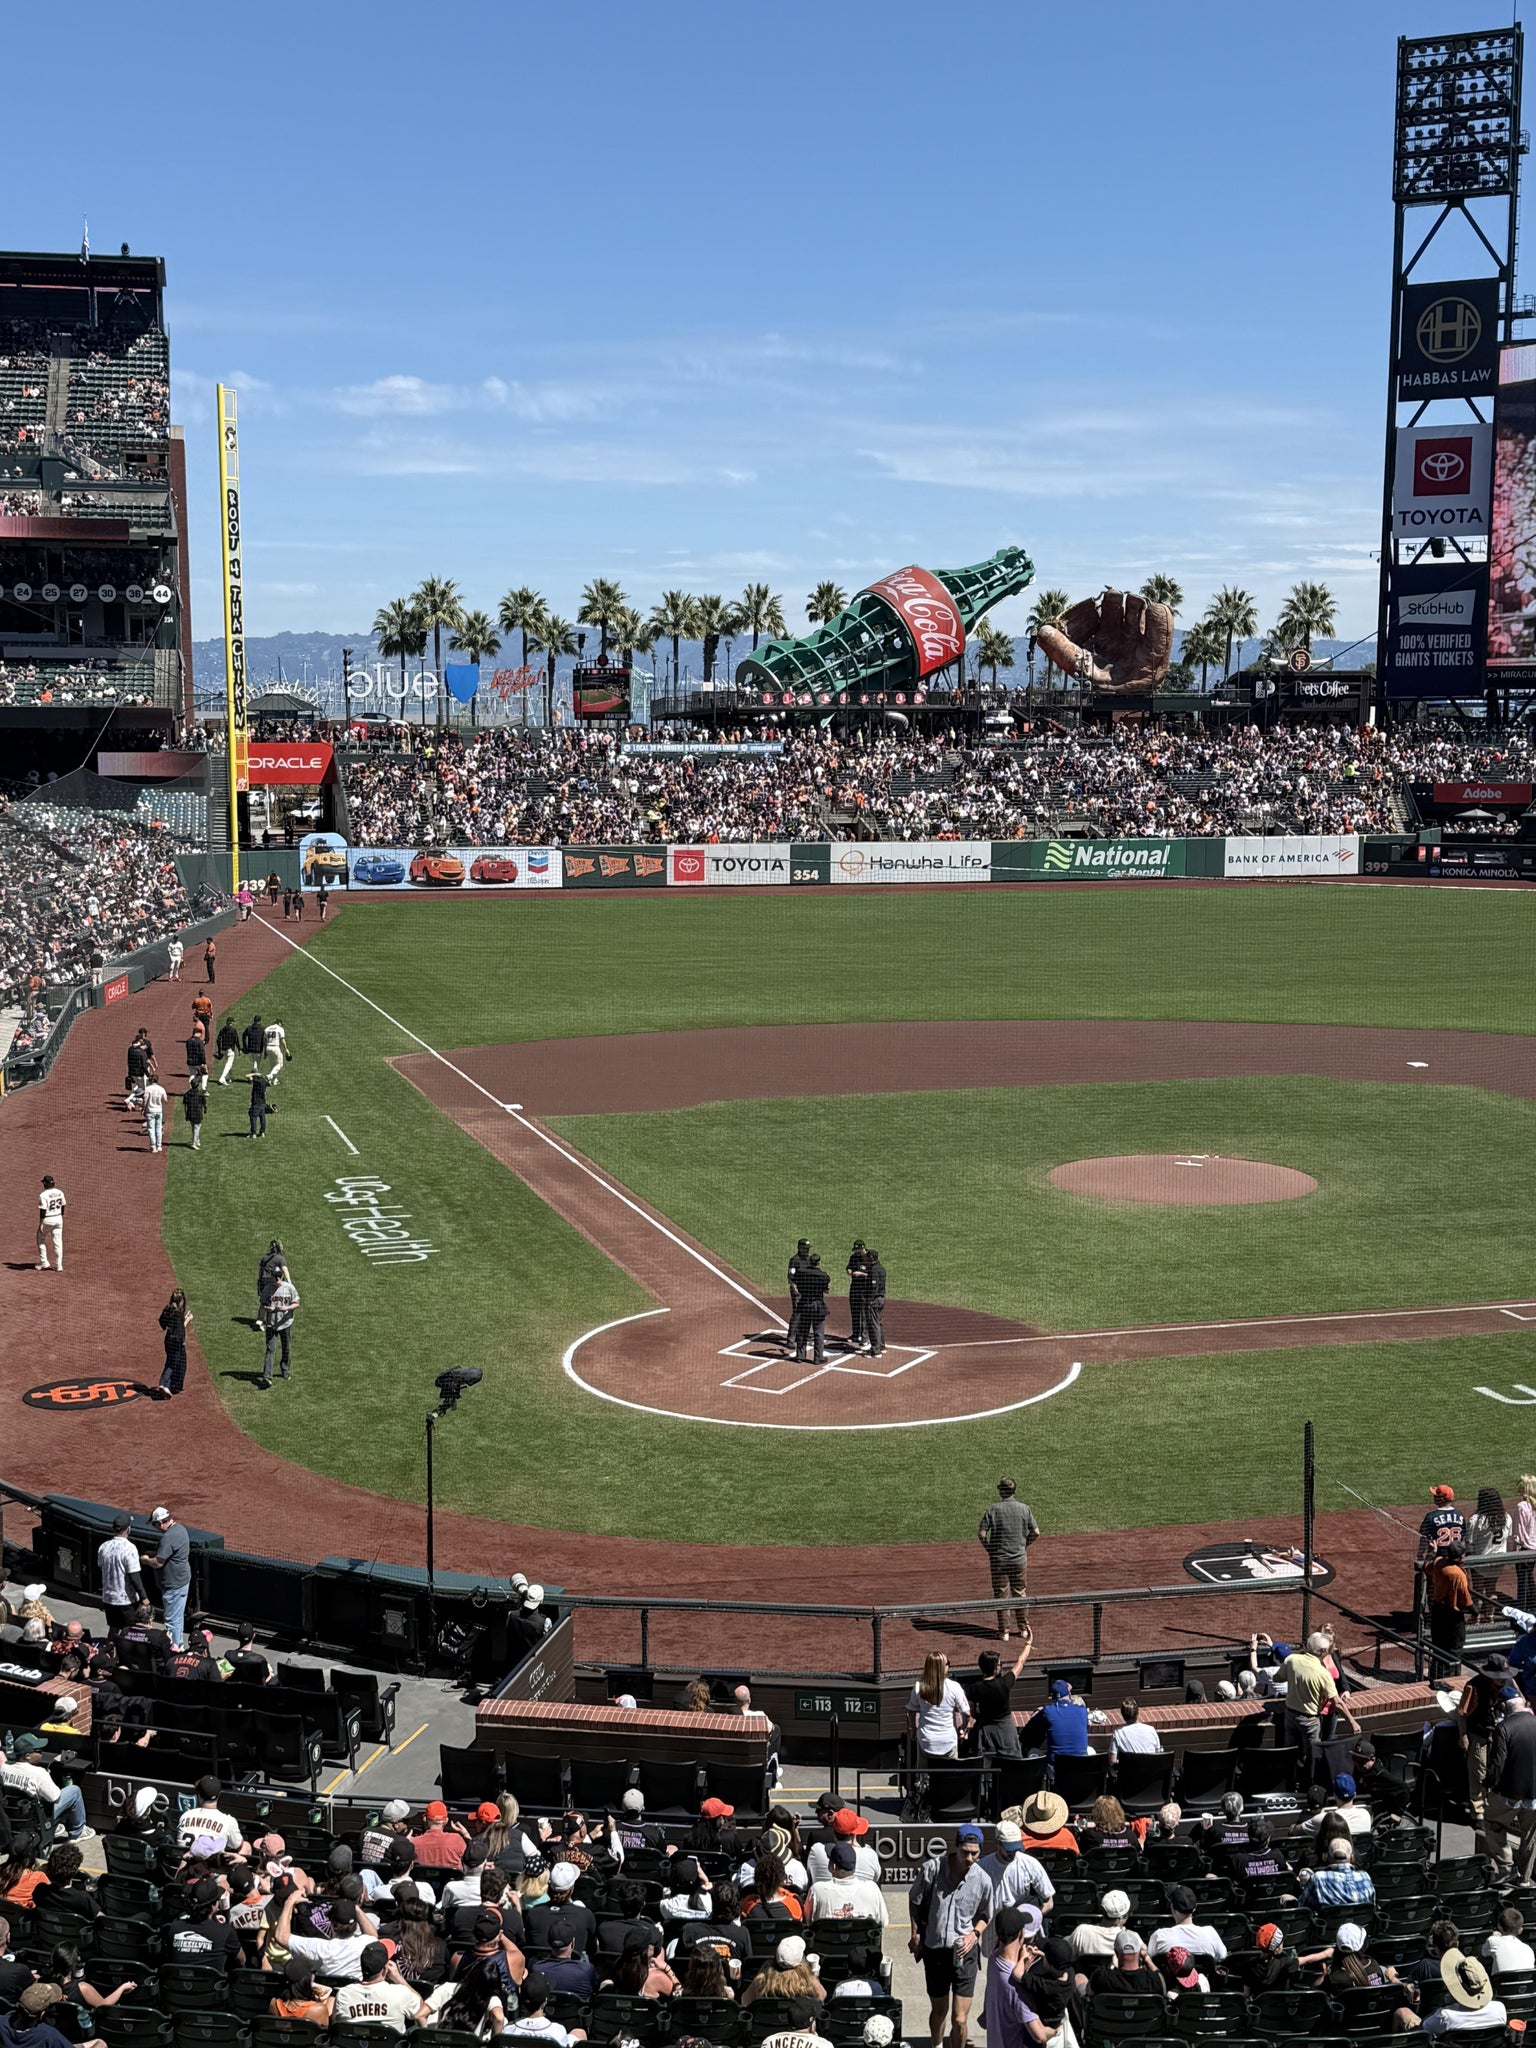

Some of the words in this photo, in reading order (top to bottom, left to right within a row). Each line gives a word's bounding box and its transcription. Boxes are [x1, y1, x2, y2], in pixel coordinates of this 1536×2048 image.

[1402, 371, 1459, 387] HABBAS
[1461, 368, 1493, 382] LAW
[228, 491, 240, 549] ROOT
[1398, 508, 1483, 526] TOYOTA
[16, 585, 30, 596] 24
[44, 587, 58, 597] 25
[73, 587, 86, 597] 27
[101, 587, 114, 598] 30
[128, 588, 142, 598] 36
[155, 588, 169, 598] 44
[231, 587, 242, 633] THA
[1408, 602, 1464, 616] StubHub
[1399, 635, 1426, 650] 100%
[1427, 633, 1472, 649] VERIFIED
[1395, 652, 1431, 667] GIANTS
[1432, 651, 1474, 666] TICKETS
[232, 641, 246, 728] CHIKIN
[347, 662, 439, 698] blue
[1320, 680, 1350, 698] Coffee
[247, 757, 323, 769] ORACLE
[1462, 788, 1502, 799] Adobe
[1075, 844, 1170, 866] National
[1228, 854, 1259, 864] BANK
[1262, 854, 1277, 864] OF
[1279, 853, 1330, 864] AMERICA
[711, 858, 785, 872] TOYOTA
[870, 856, 944, 870] Hanwha
[948, 855, 983, 869] Life
[1365, 862, 1389, 873] 399
[793, 869, 820, 881] 354
[1442, 867, 1477, 877] KONICA
[1479, 868, 1519, 878] MINOLTA
[238, 880, 267, 891] 339
[49, 1198, 62, 1212] 23
[335, 1205, 441, 1265] Health
[1433, 1513, 1464, 1527] SEALS
[815, 1700, 832, 1711] 113
[844, 1700, 861, 1713] 112
[107, 1779, 169, 1813] ble
[181, 1816, 224, 1833] CRAWFORD
[876, 1830, 948, 1860] blue
[885, 1867, 921, 1882] FIEL
[349, 2003, 388, 2019] DEVERS
